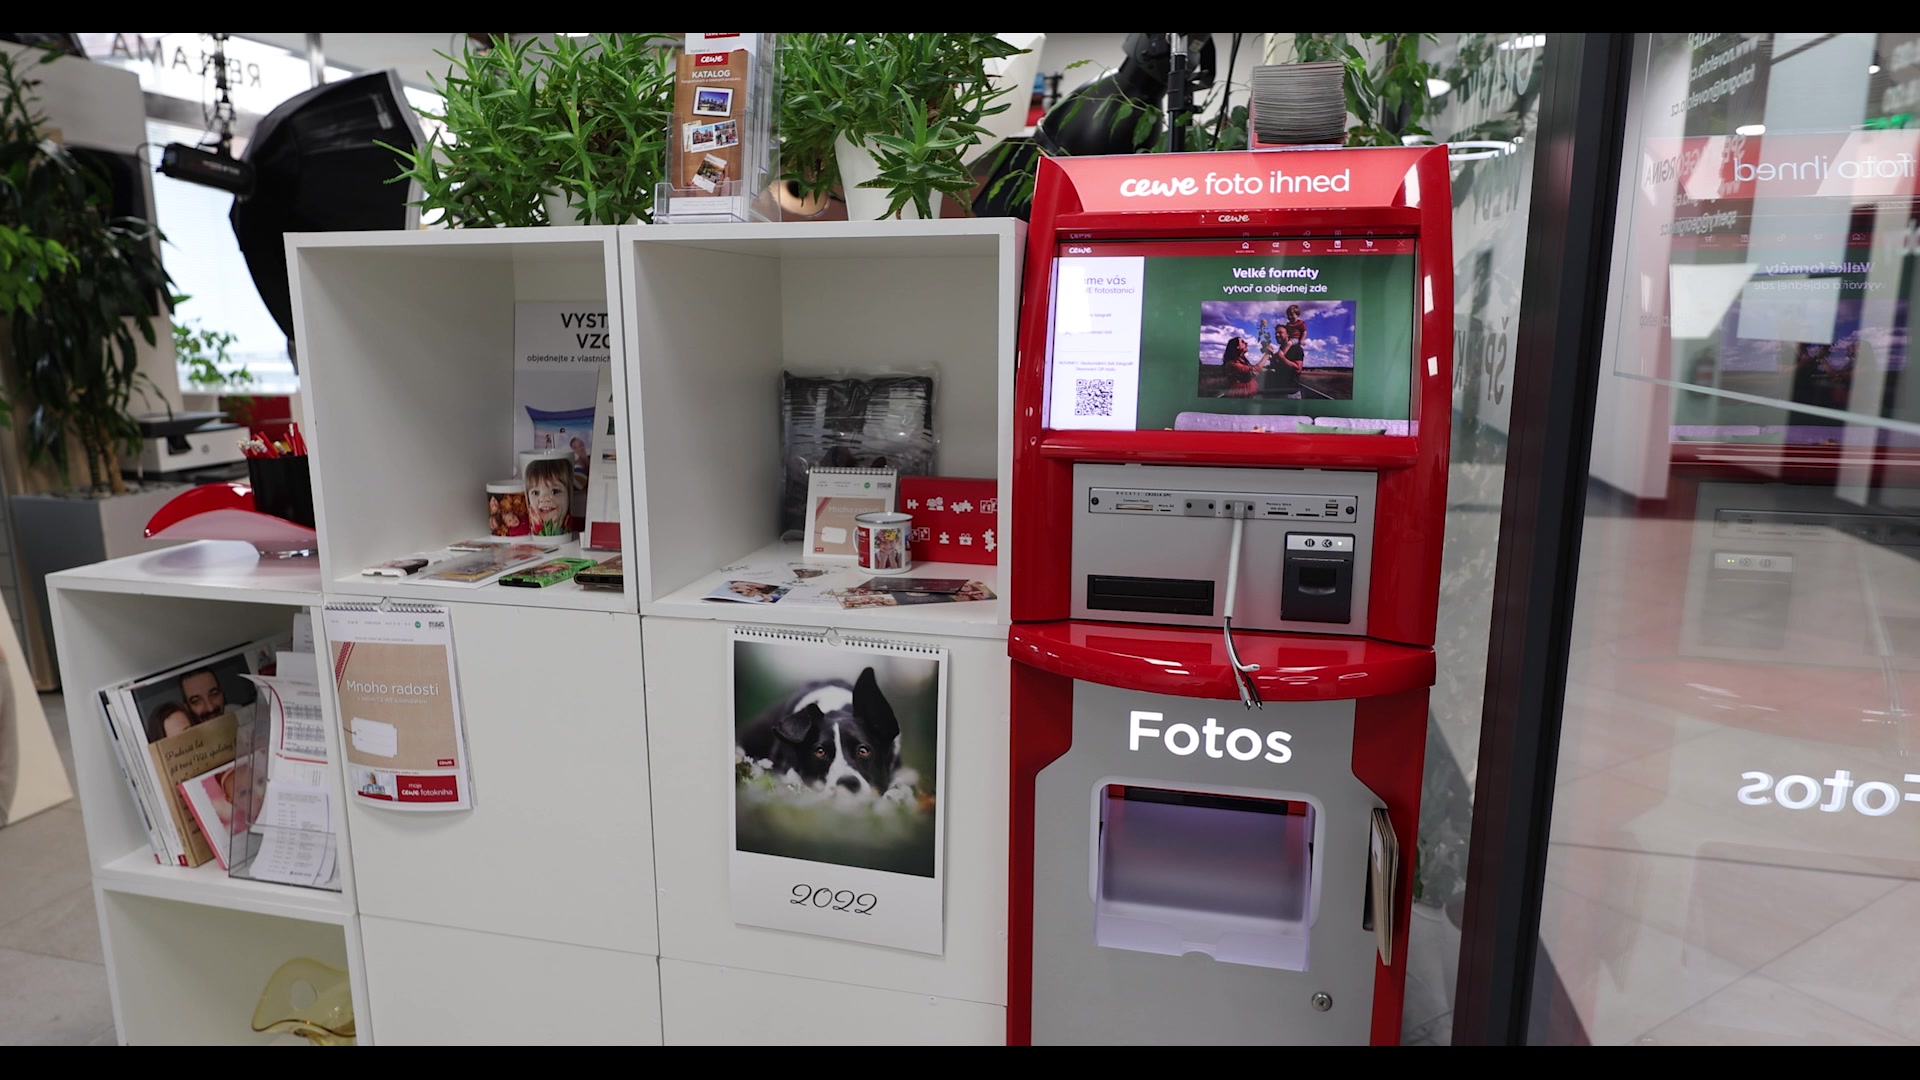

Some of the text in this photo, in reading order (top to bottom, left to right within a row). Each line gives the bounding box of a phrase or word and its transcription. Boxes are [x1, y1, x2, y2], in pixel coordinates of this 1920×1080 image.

[700, 55, 723, 63] cewe
[692, 69, 731, 79] KATALOG
[1120, 169, 1351, 198] cewe foto ihned
[1218, 214, 1250, 222] cewe
[1069, 246, 1092, 254] cewe
[1233, 266, 1319, 280] Velké formáty
[1107, 275, 1127, 285] vás
[1223, 283, 1328, 294] vytvoř a objednej zde
[561, 313, 609, 328] VYST
[527, 354, 569, 363] objednejte
[346, 680, 440, 696] Mnoho radosti
[1128, 709, 1293, 764] Fotos
[420, 788, 453, 796] fotokniha
[789, 883, 879, 917] 2022
